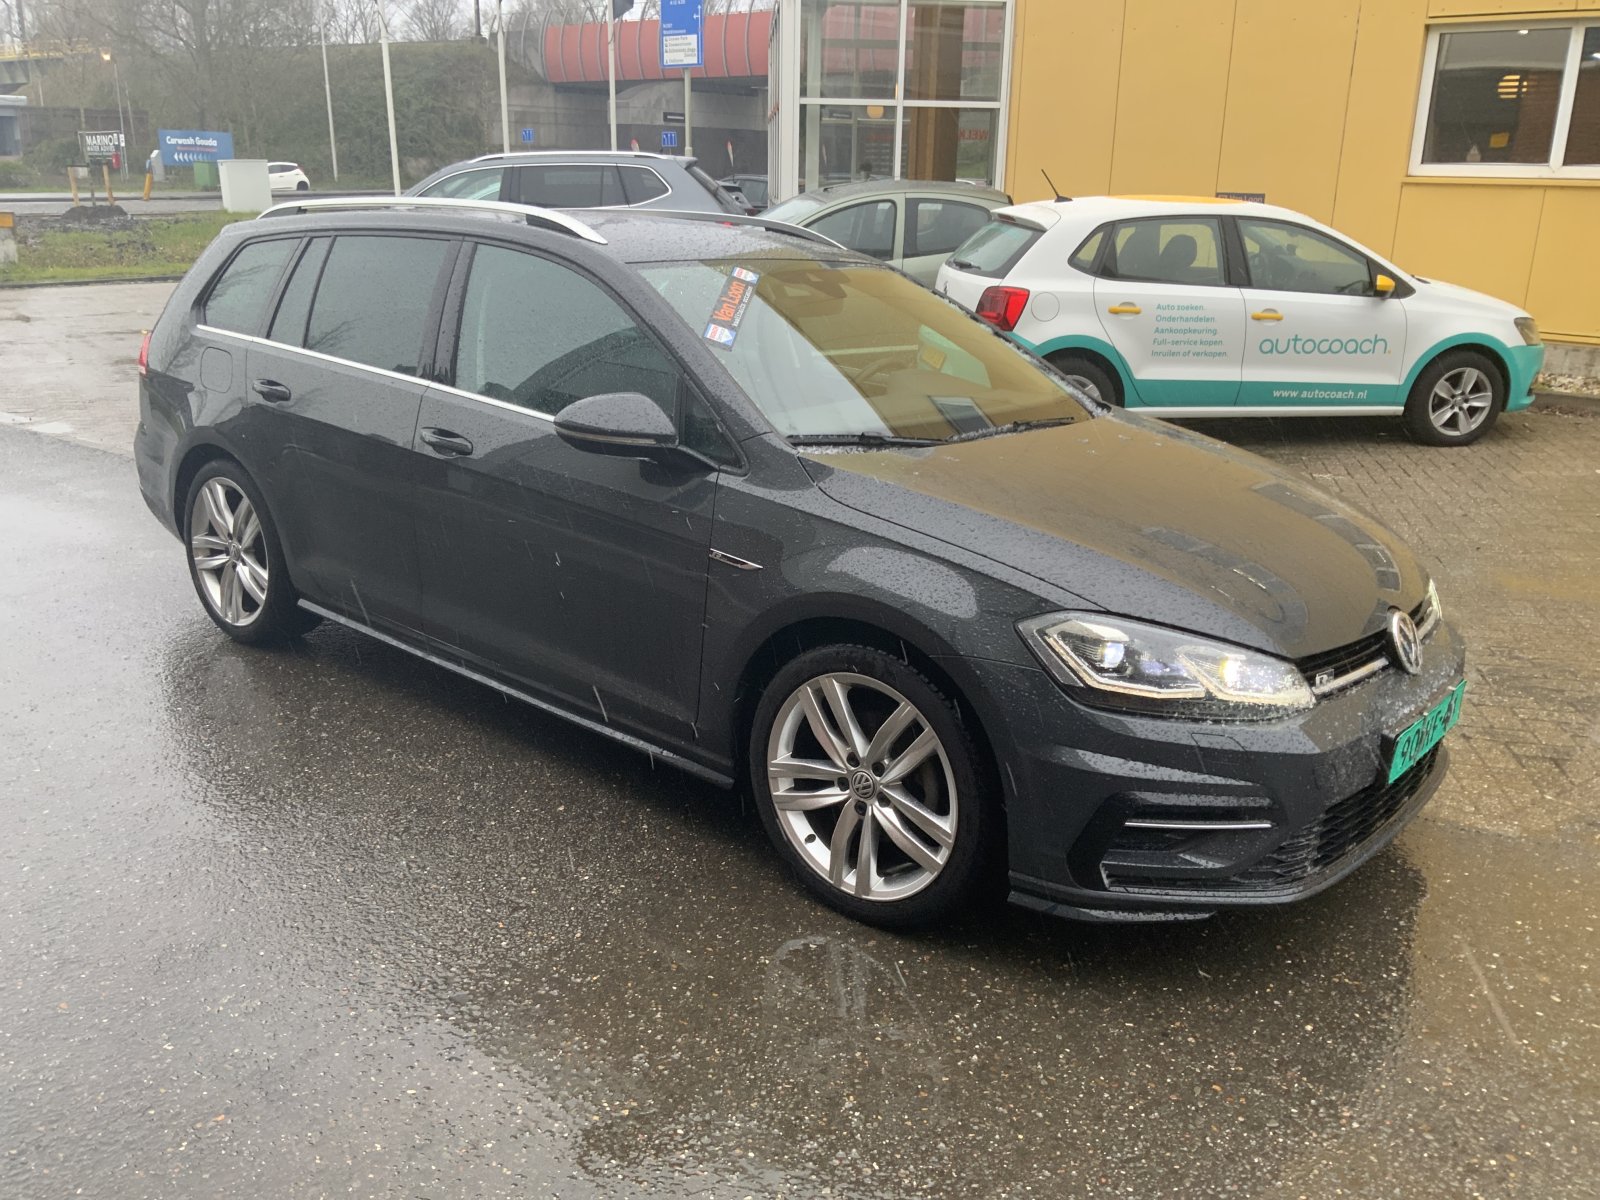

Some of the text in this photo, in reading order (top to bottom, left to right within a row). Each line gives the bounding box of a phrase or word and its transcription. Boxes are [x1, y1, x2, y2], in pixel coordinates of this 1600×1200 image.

[86, 134, 113, 146] MARINO
[720, 281, 746, 305] Loon
[713, 302, 737, 321] Van
[1152, 338, 1198, 346] Full-service
